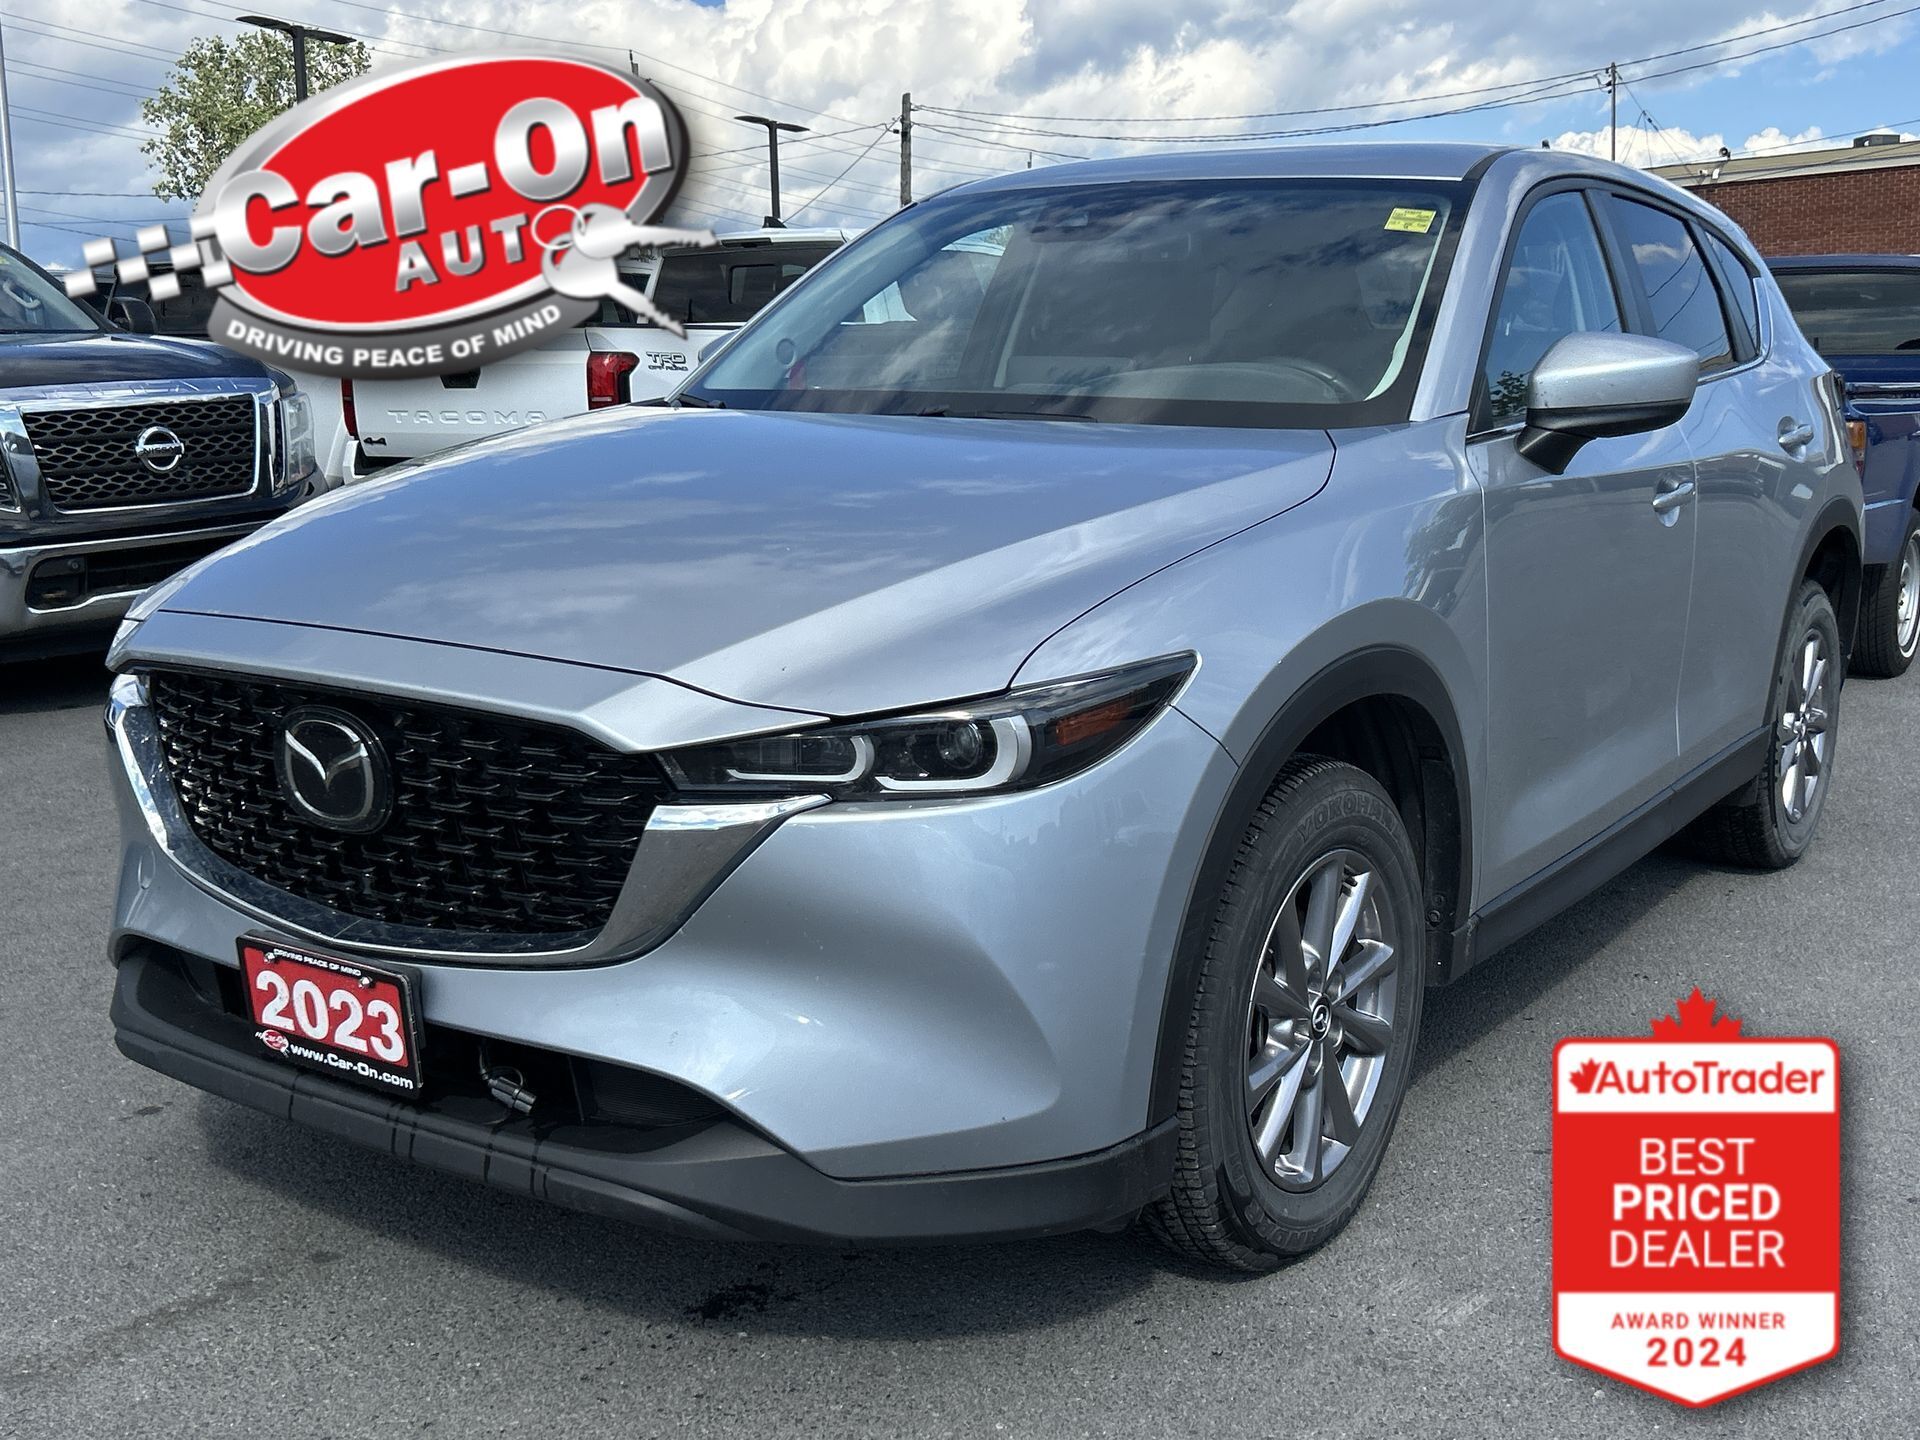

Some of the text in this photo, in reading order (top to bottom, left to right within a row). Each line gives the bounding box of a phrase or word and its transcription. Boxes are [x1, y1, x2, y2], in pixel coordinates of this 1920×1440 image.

[646, 351, 686, 367] TRD
[387, 410, 548, 425] TACOMA
[273, 948, 362, 977] DRIVING PEACE OF MIND
[256, 970, 404, 1062] 2023
[290, 1043, 414, 1091] www.Car-On.com
